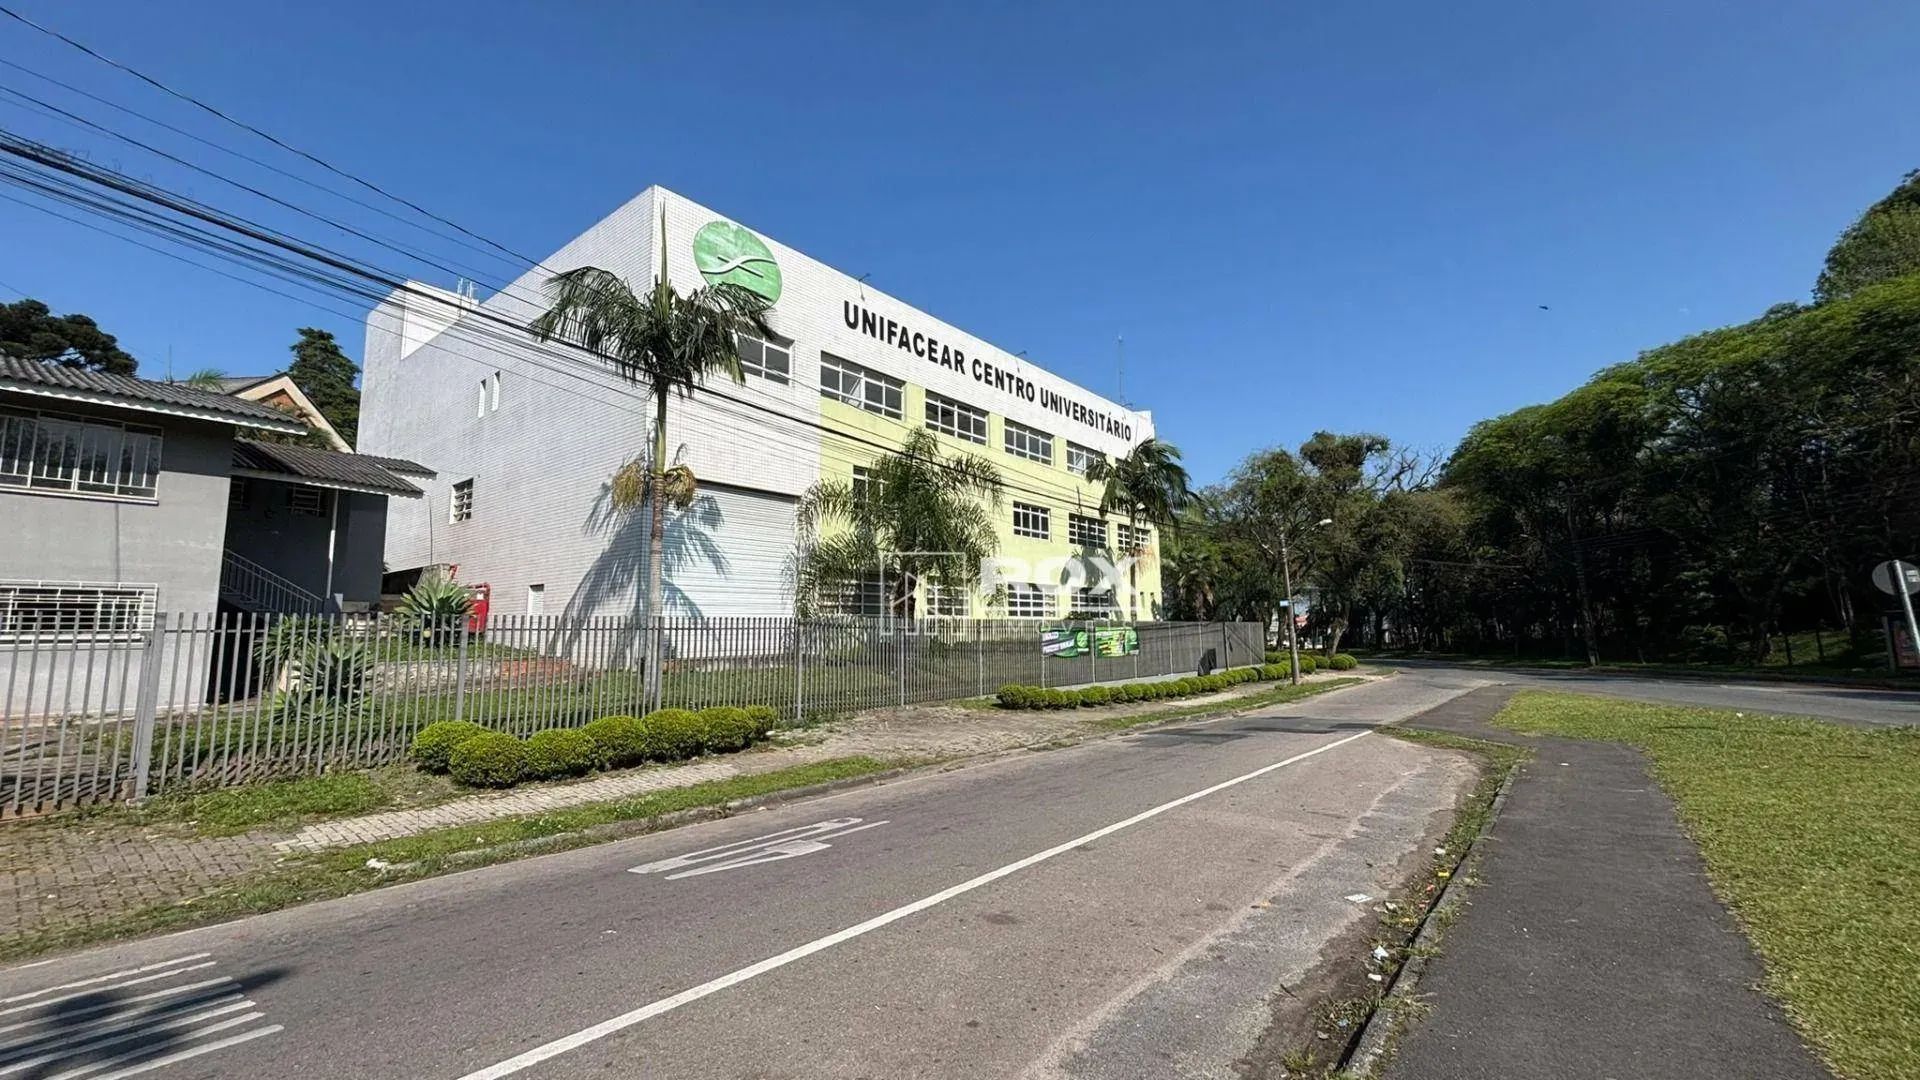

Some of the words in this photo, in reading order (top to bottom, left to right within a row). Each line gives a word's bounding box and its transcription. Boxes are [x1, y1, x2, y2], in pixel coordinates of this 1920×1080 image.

[843, 300, 966, 375] UNIFACEAR
[972, 358, 1035, 402] CENTRO
[1039, 387, 1132, 442] UNIVERSITÁRIO
